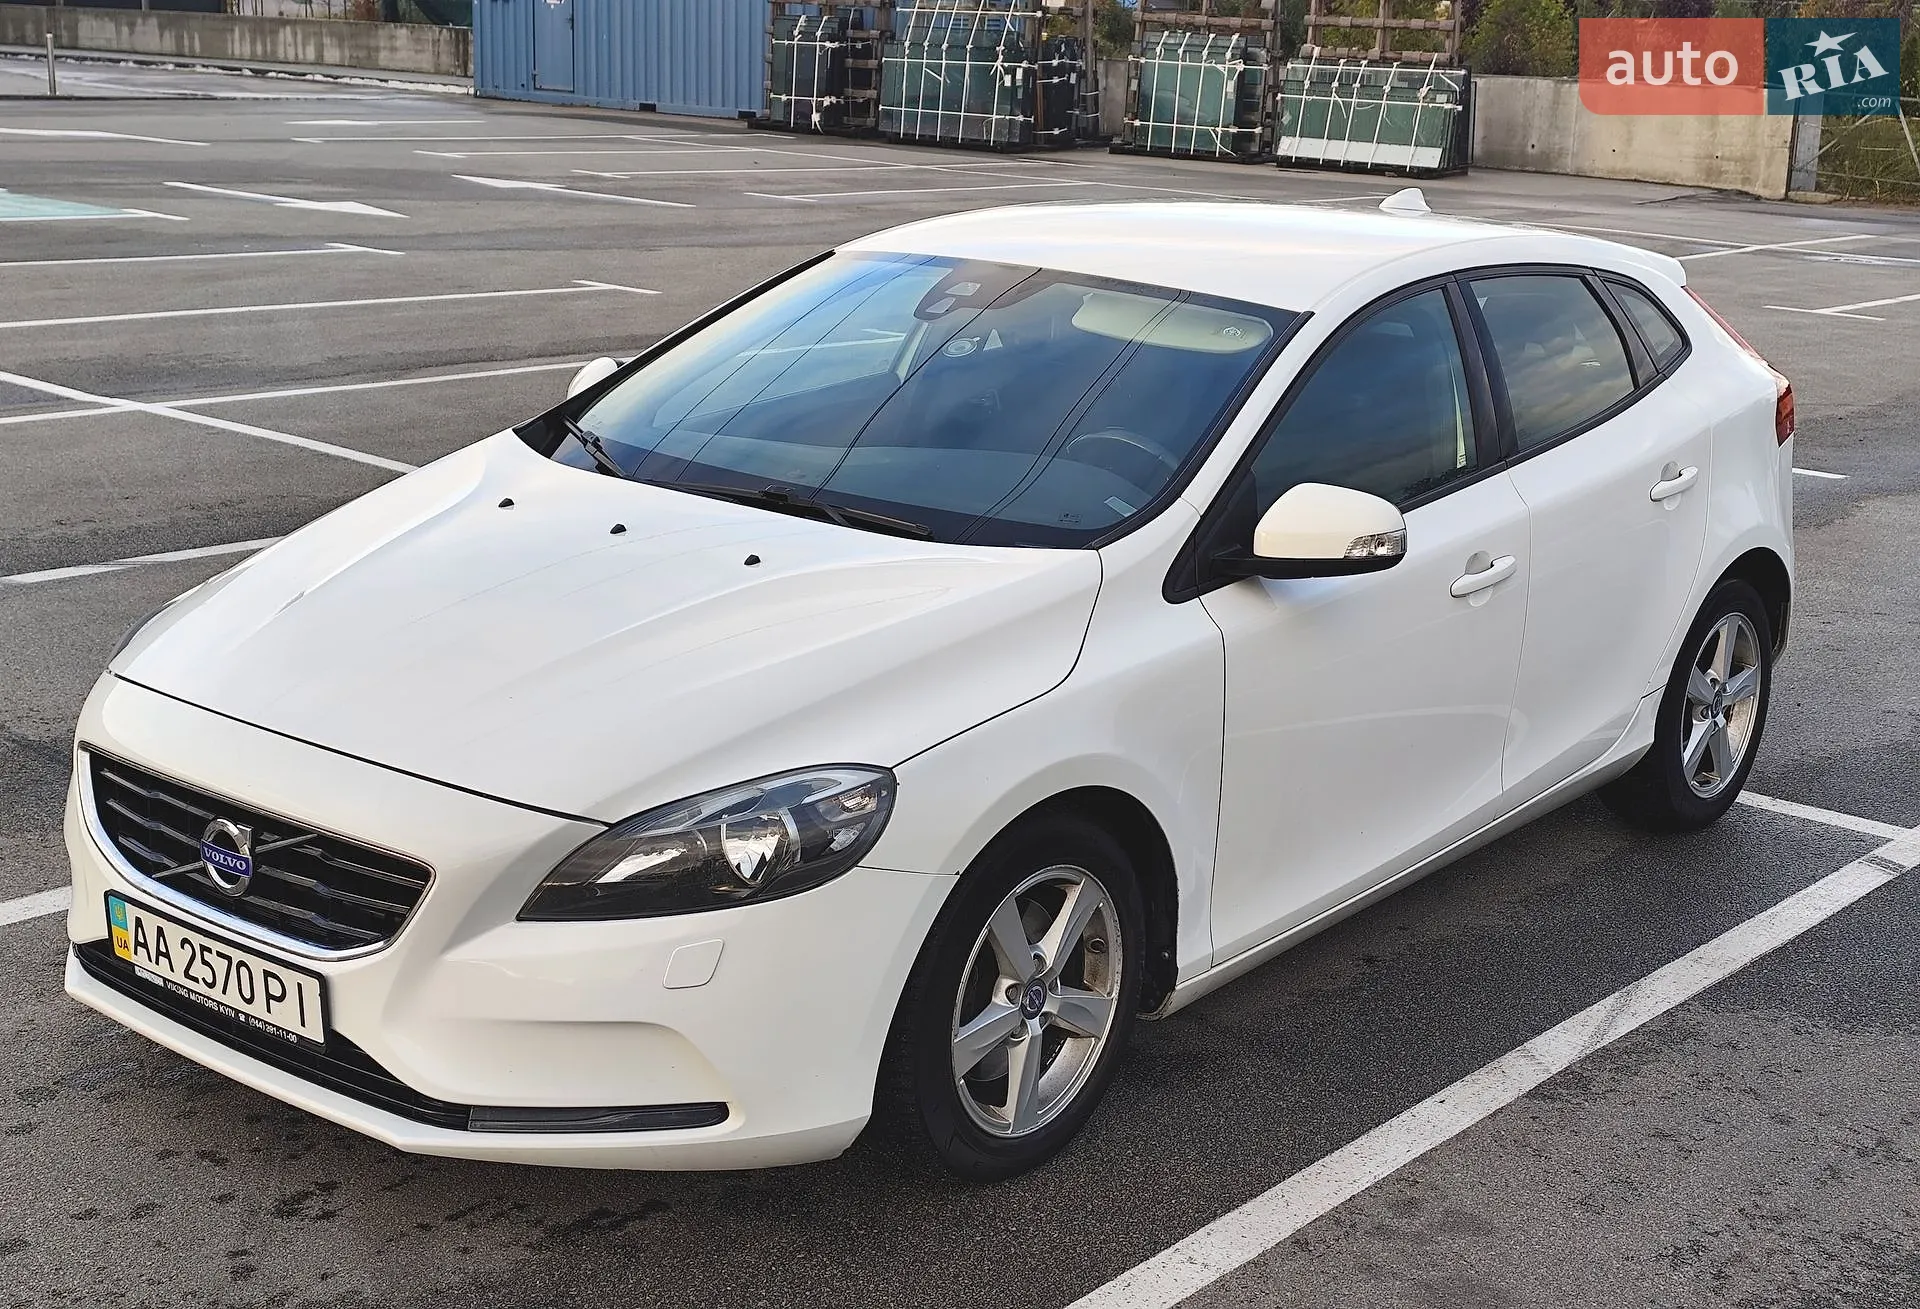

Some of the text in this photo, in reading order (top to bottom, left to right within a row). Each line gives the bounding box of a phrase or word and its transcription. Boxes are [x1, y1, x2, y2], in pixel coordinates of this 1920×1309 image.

[203, 847, 246, 870] VOLVO
[116, 938, 130, 952] UA
[133, 916, 175, 973] AA
[179, 938, 256, 1005] 2570
[166, 980, 189, 998] VIKING
[190, 991, 218, 1011] MOTORS
